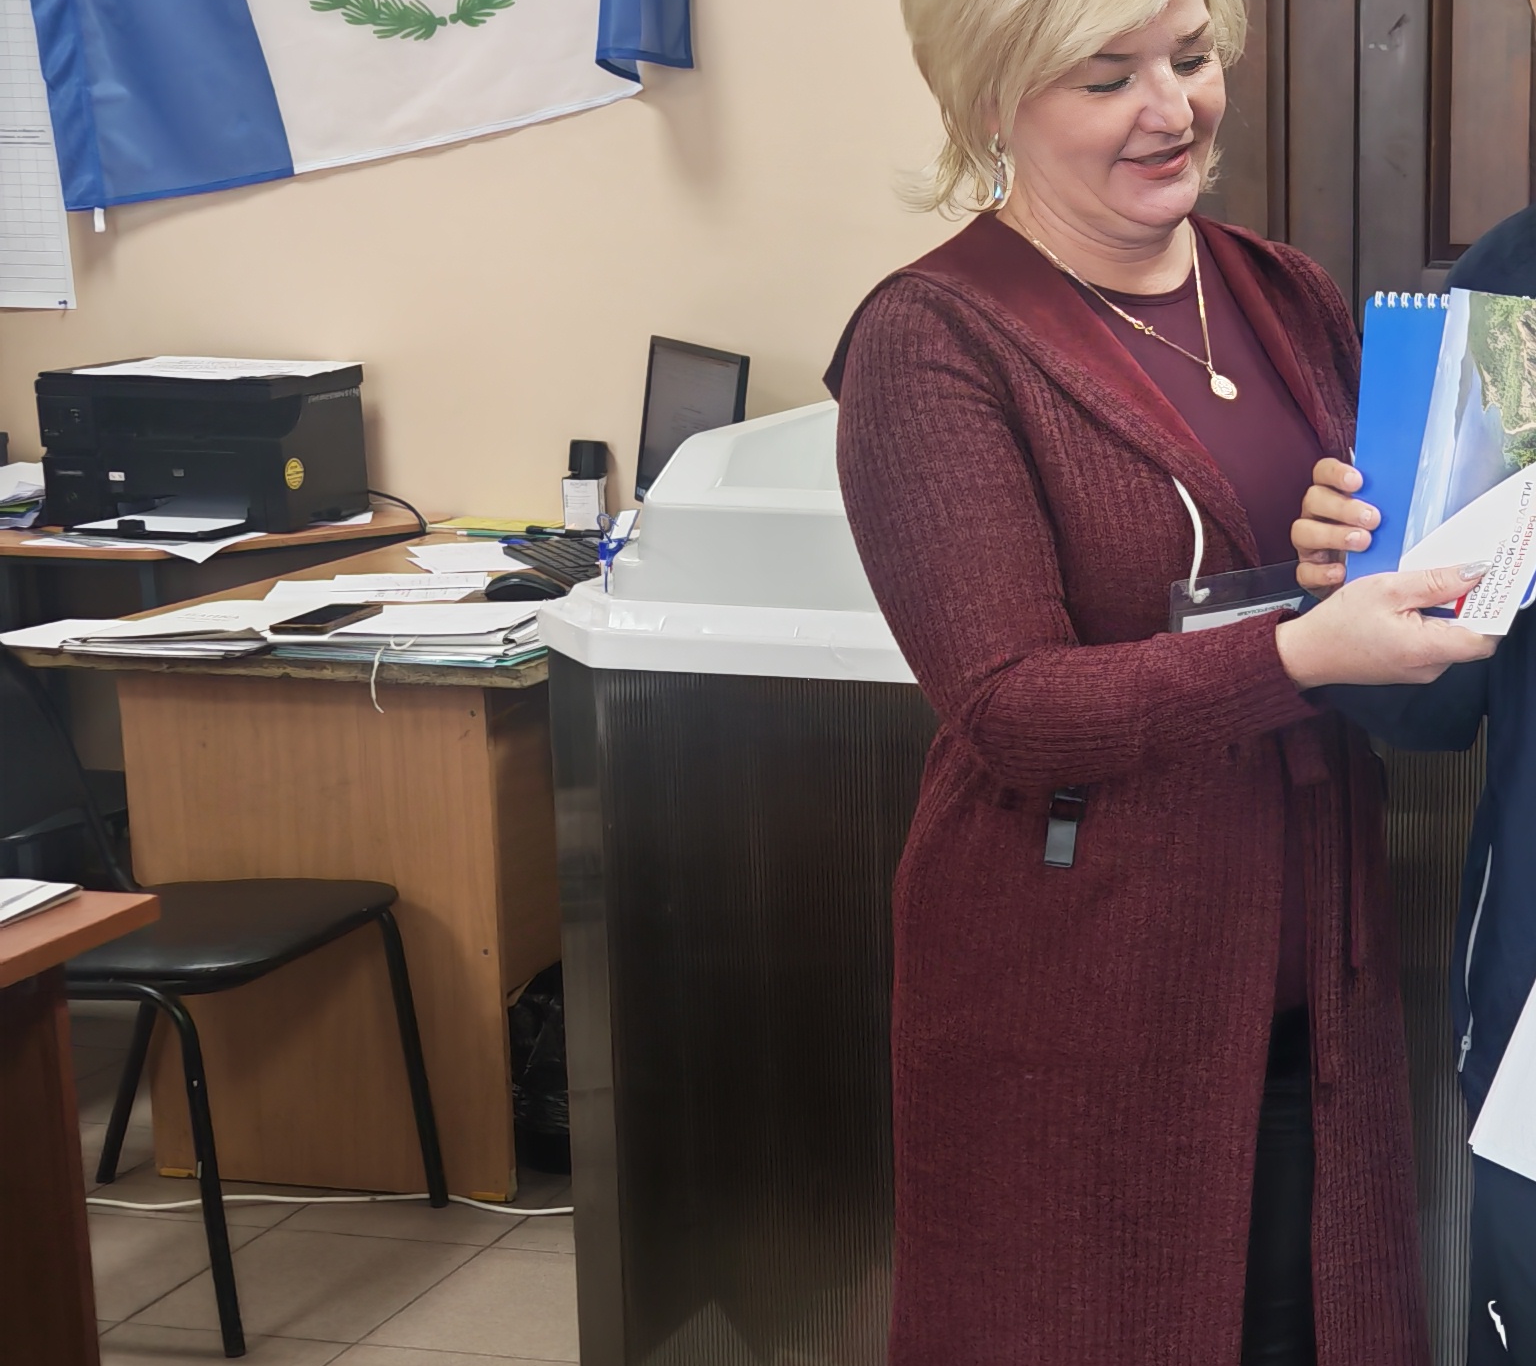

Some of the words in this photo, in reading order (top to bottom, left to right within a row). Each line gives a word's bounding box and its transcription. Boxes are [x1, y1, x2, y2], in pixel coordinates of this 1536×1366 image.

[1472, 539, 1508, 619] ГУБЕРНАТОРА
[1481, 547, 1517, 619] ИРКУТСКОЙ
[1512, 481, 1534, 544] ОБЛАСТИ
[1462, 572, 1486, 619] ВЫБО
